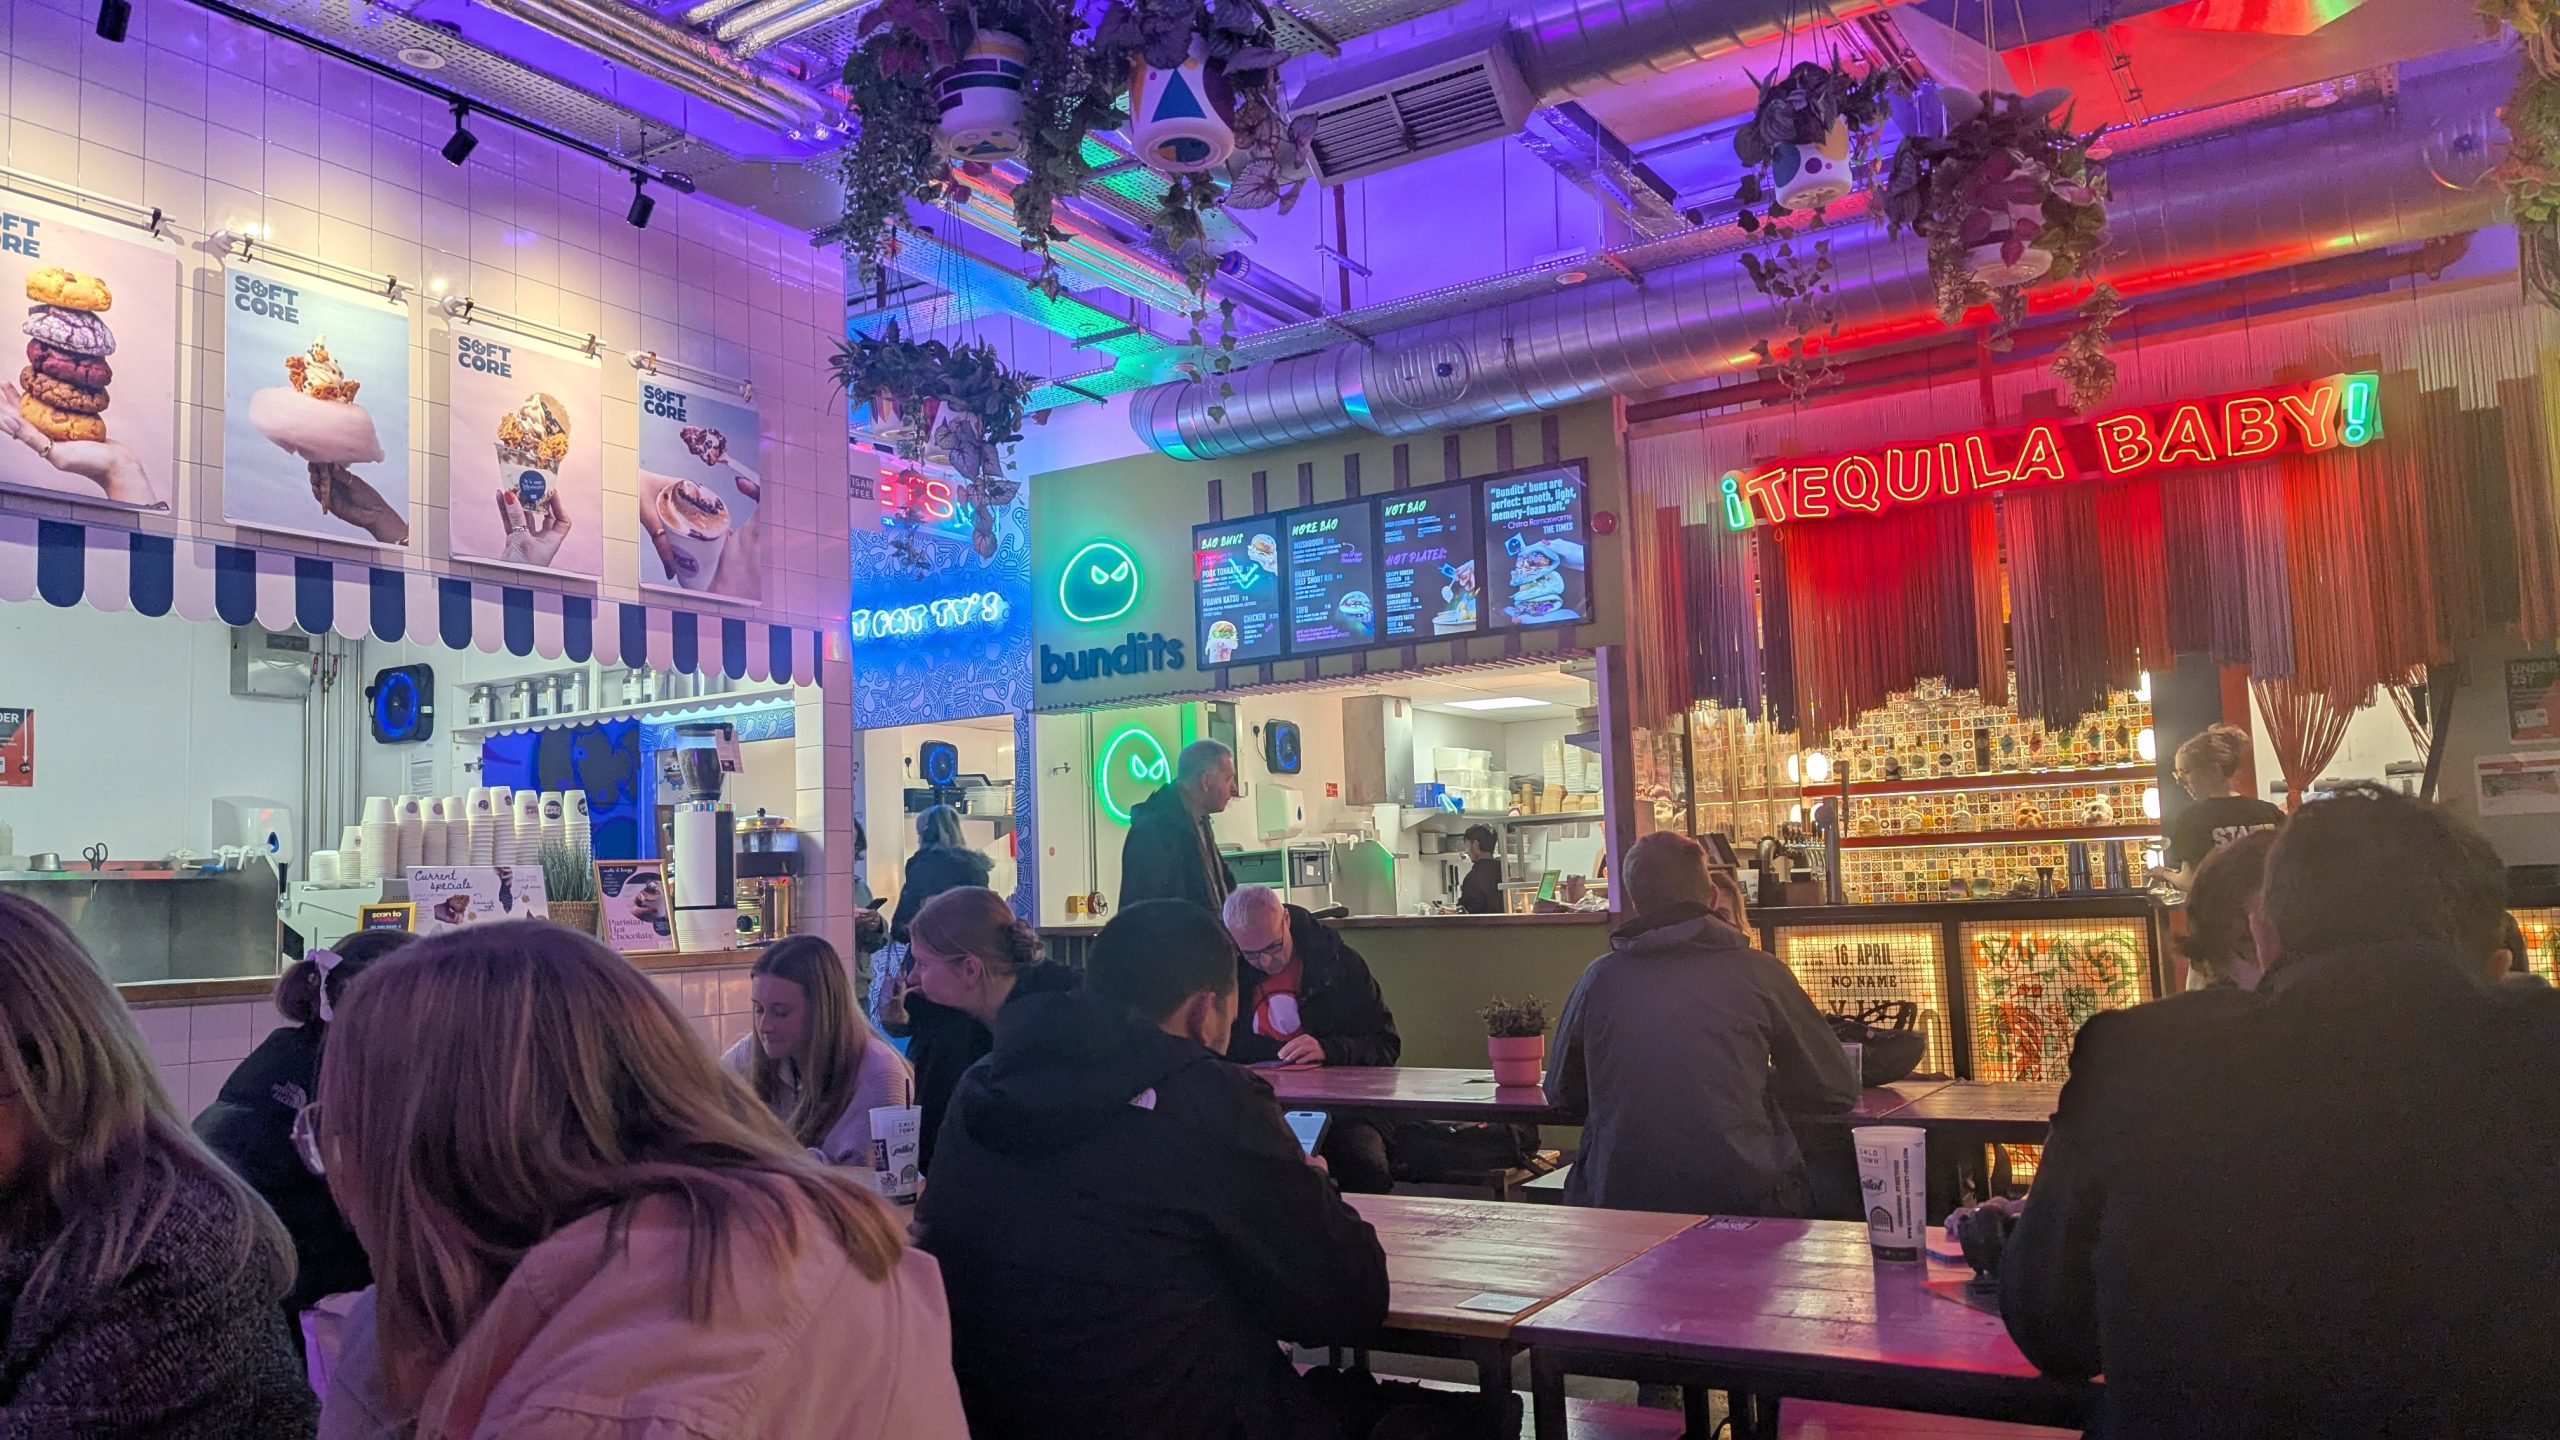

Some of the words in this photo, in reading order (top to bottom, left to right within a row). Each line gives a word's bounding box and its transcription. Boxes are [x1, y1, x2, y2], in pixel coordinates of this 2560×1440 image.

[0, 212, 40, 237] FT
[0, 232, 40, 259] RE
[235, 275, 299, 306] SOFT
[235, 293, 299, 325] CORE
[458, 335, 512, 362] SOFT
[458, 352, 512, 379] CORE
[644, 385, 687, 408] SOFT
[644, 400, 687, 423] CORE
[2098, 377, 2376, 476] BABY!
[851, 479, 873, 489] ISAN
[1529, 481, 1548, 492] buns
[1549, 478, 1563, 489] are
[1406, 500, 1427, 514] BAO
[1491, 497, 1521, 513] perfect:
[1522, 491, 1553, 505] smooth,
[1555, 487, 1577, 500] light,
[1491, 505, 1546, 522] memory-foam
[1292, 521, 1318, 536] MORE
[1320, 518, 1338, 532] BAO
[1543, 525, 1557, 535] THE
[1558, 522, 1574, 532] TIMES
[1201, 537, 1219, 550] BAO
[1220, 533, 1244, 547] BUNS
[1293, 537, 1324, 549] MUSHROOM
[1386, 552, 1408, 566] HOT
[1202, 568, 1216, 578] PORK
[1294, 577, 1306, 586] BEEF
[1307, 574, 1323, 584] SHORT
[1203, 597, 1222, 607] PRAWN
[1222, 594, 1240, 604] KATSU
[1296, 606, 1309, 614] TOFU
[1243, 613, 1266, 624] CHICKEN
[1039, 632, 1185, 684] bundits
[414, 870, 458, 881] Current
[430, 878, 473, 892] specials
[608, 918, 643, 927] Parisian
[609, 926, 625, 934] Hot
[610, 932, 653, 941] Chocolate
[1834, 943, 1853, 966] 16.
[1857, 943, 1893, 966] APRIL
[1831, 976, 1852, 988] NO
[1857, 975, 1897, 988] NAME
